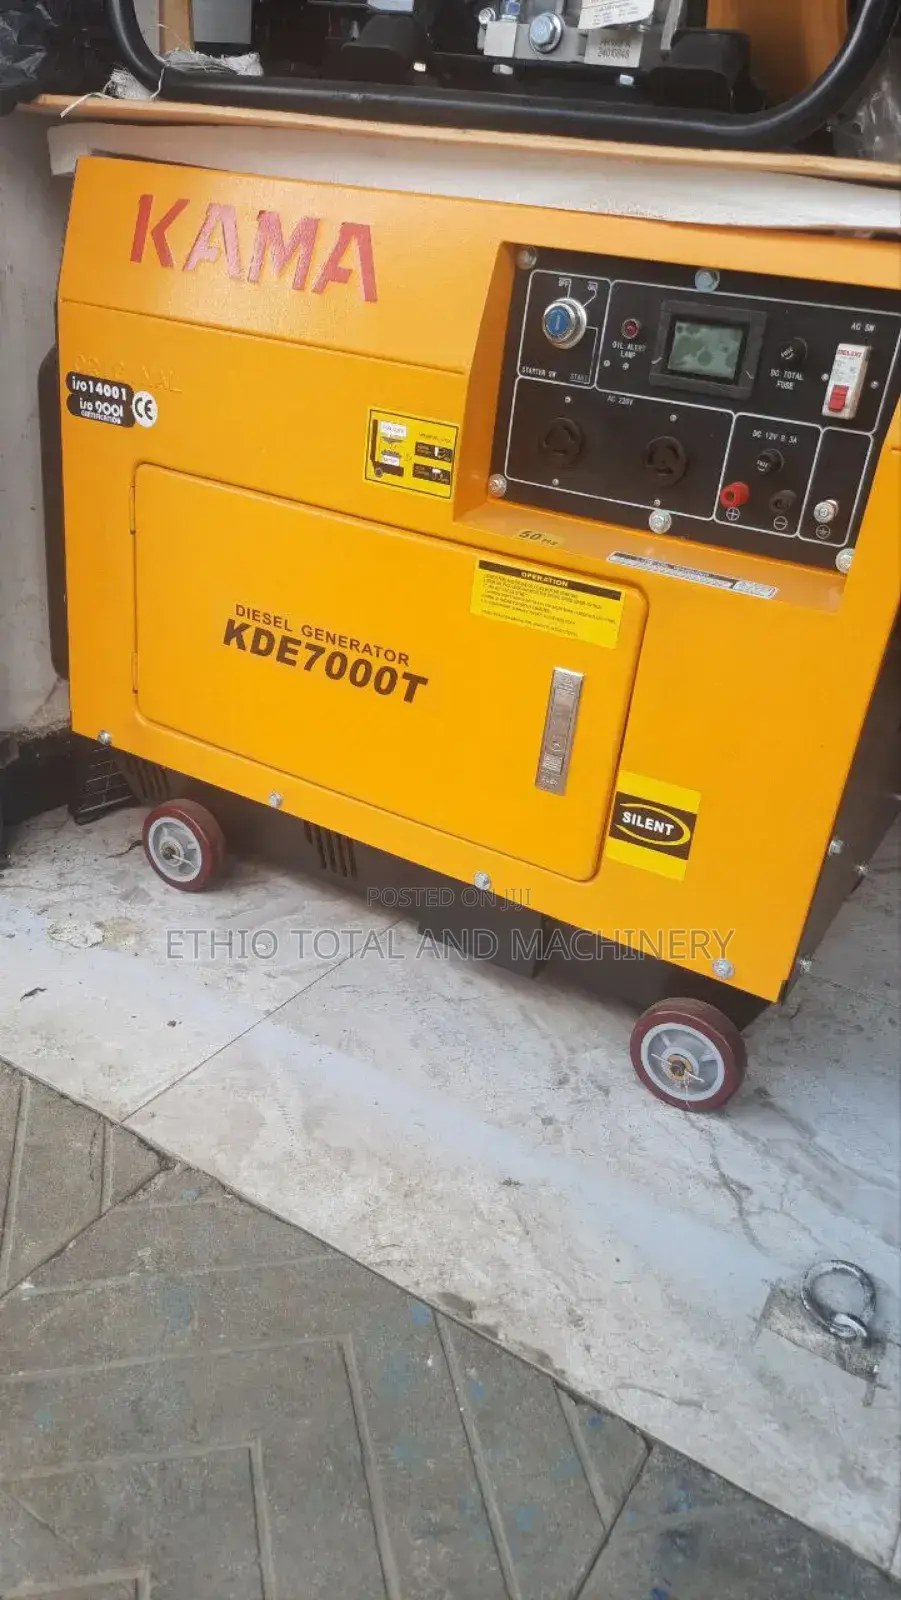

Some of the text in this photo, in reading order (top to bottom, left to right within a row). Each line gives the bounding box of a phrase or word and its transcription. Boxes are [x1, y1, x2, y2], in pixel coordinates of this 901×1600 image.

[130, 193, 378, 302] KAMA
[851, 322, 861, 331] AC
[783, 370, 804, 381] TOTAL
[776, 380, 794, 390] FUSE
[518, 530, 542, 541] 50
[520, 571, 569, 588] OPERATION
[235, 603, 410, 667] DIESEL GENERATOR
[222, 618, 429, 704] KDE7000T
[621, 810, 675, 837] SILENT
